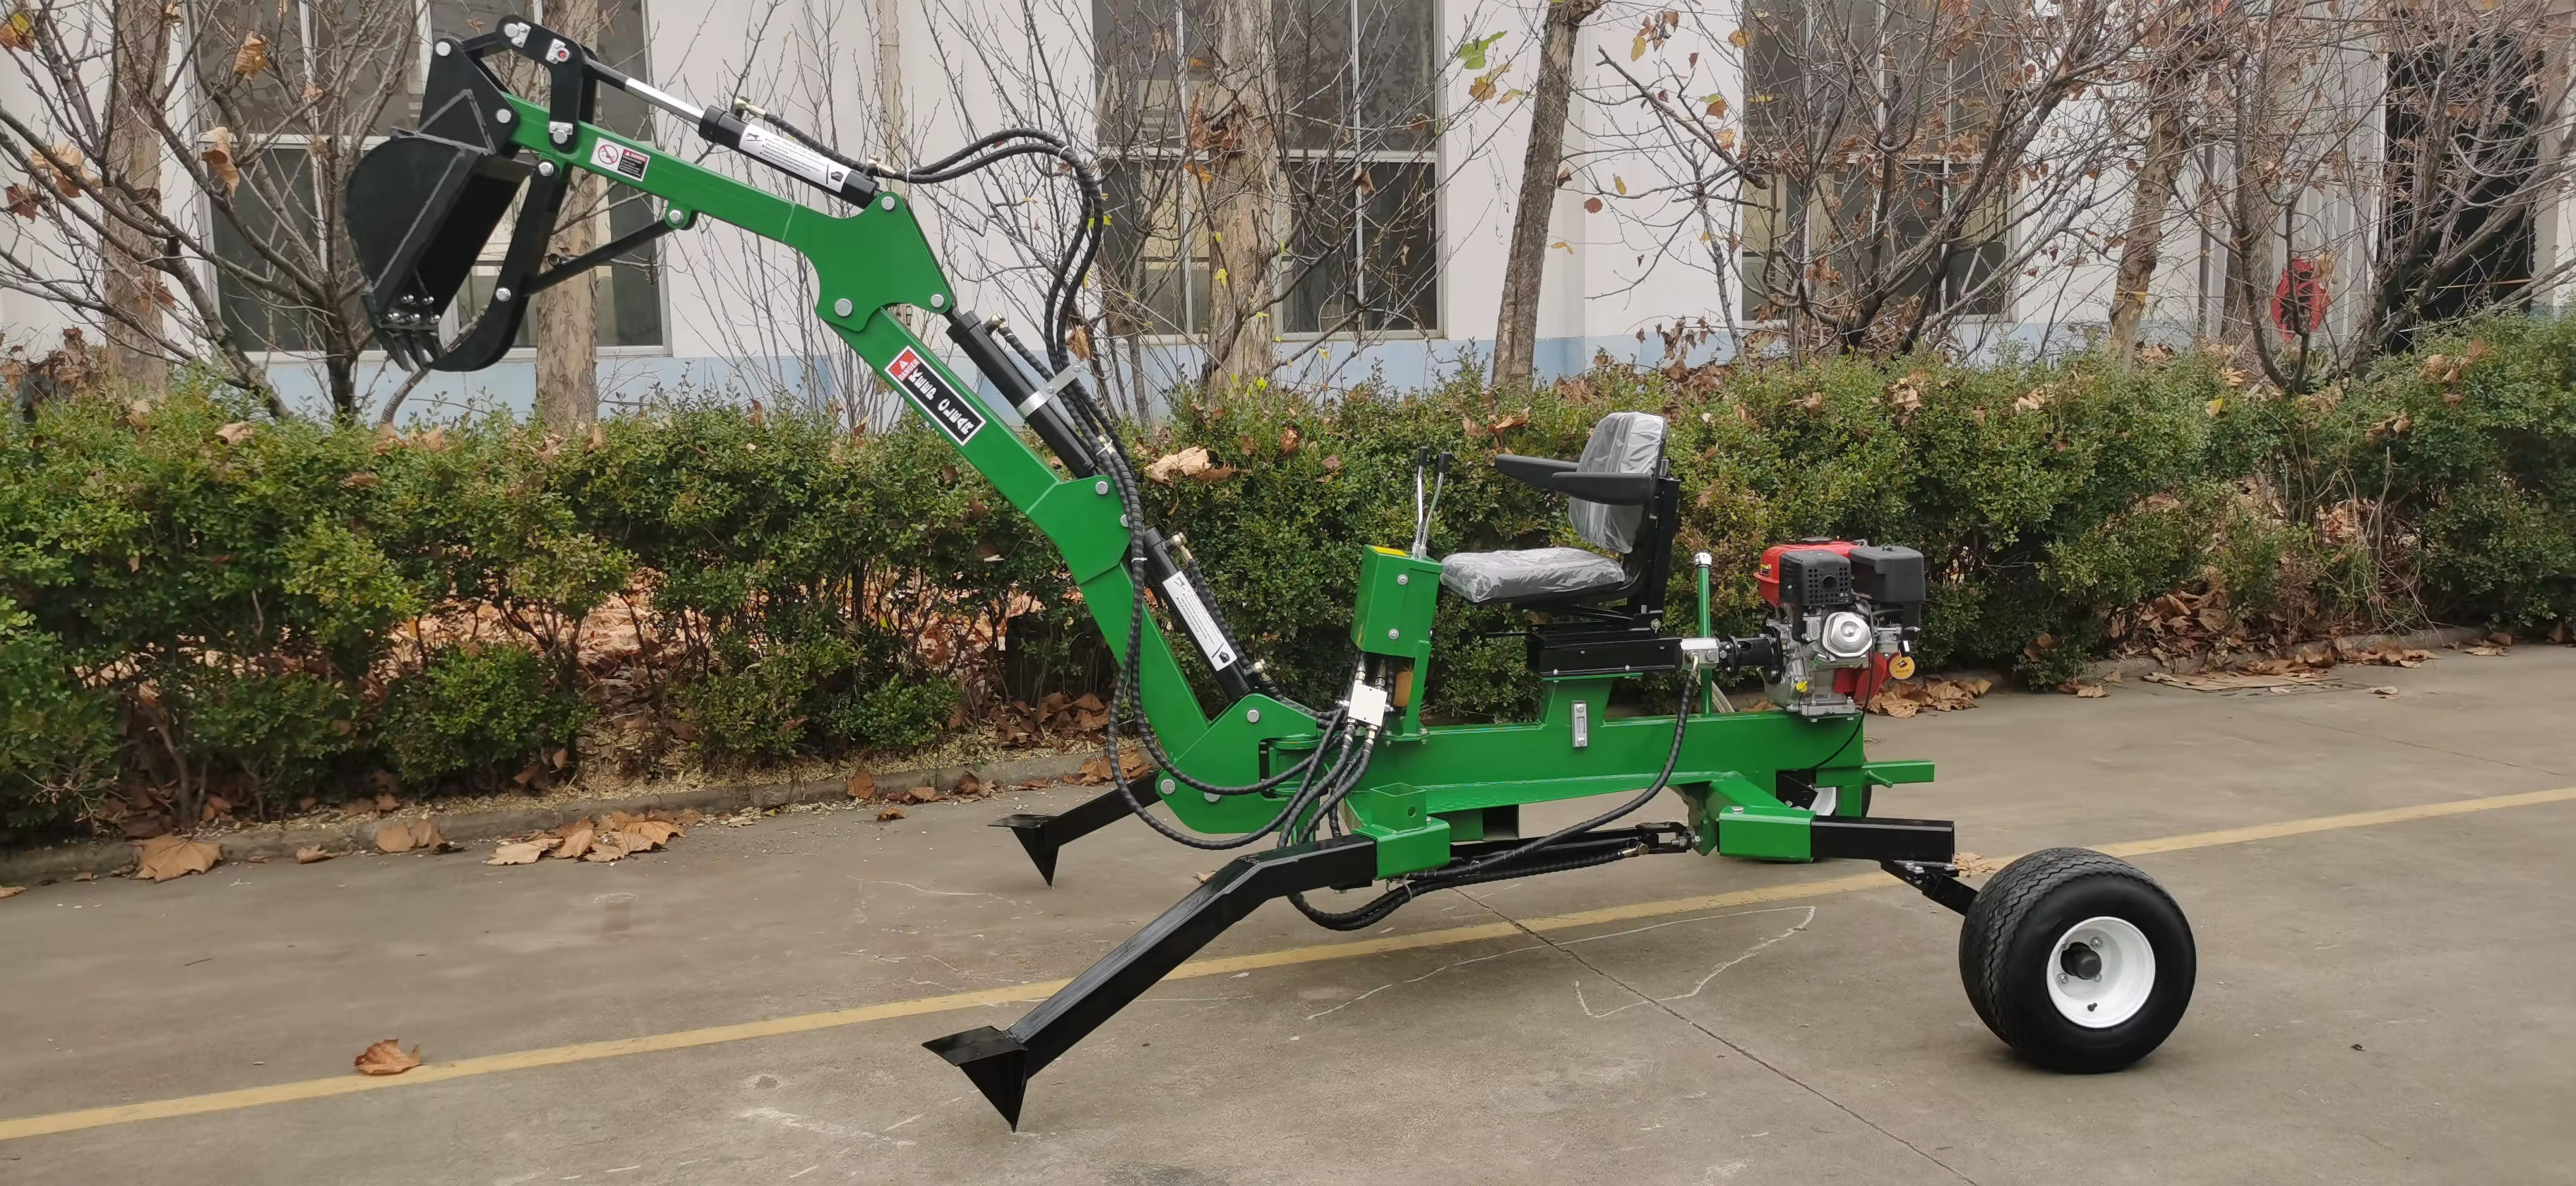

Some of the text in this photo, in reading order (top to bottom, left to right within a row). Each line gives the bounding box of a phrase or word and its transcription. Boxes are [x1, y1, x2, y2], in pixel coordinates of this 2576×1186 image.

[898, 359, 920, 381] DANGER
[908, 368, 974, 435] KEEP CLEAR
